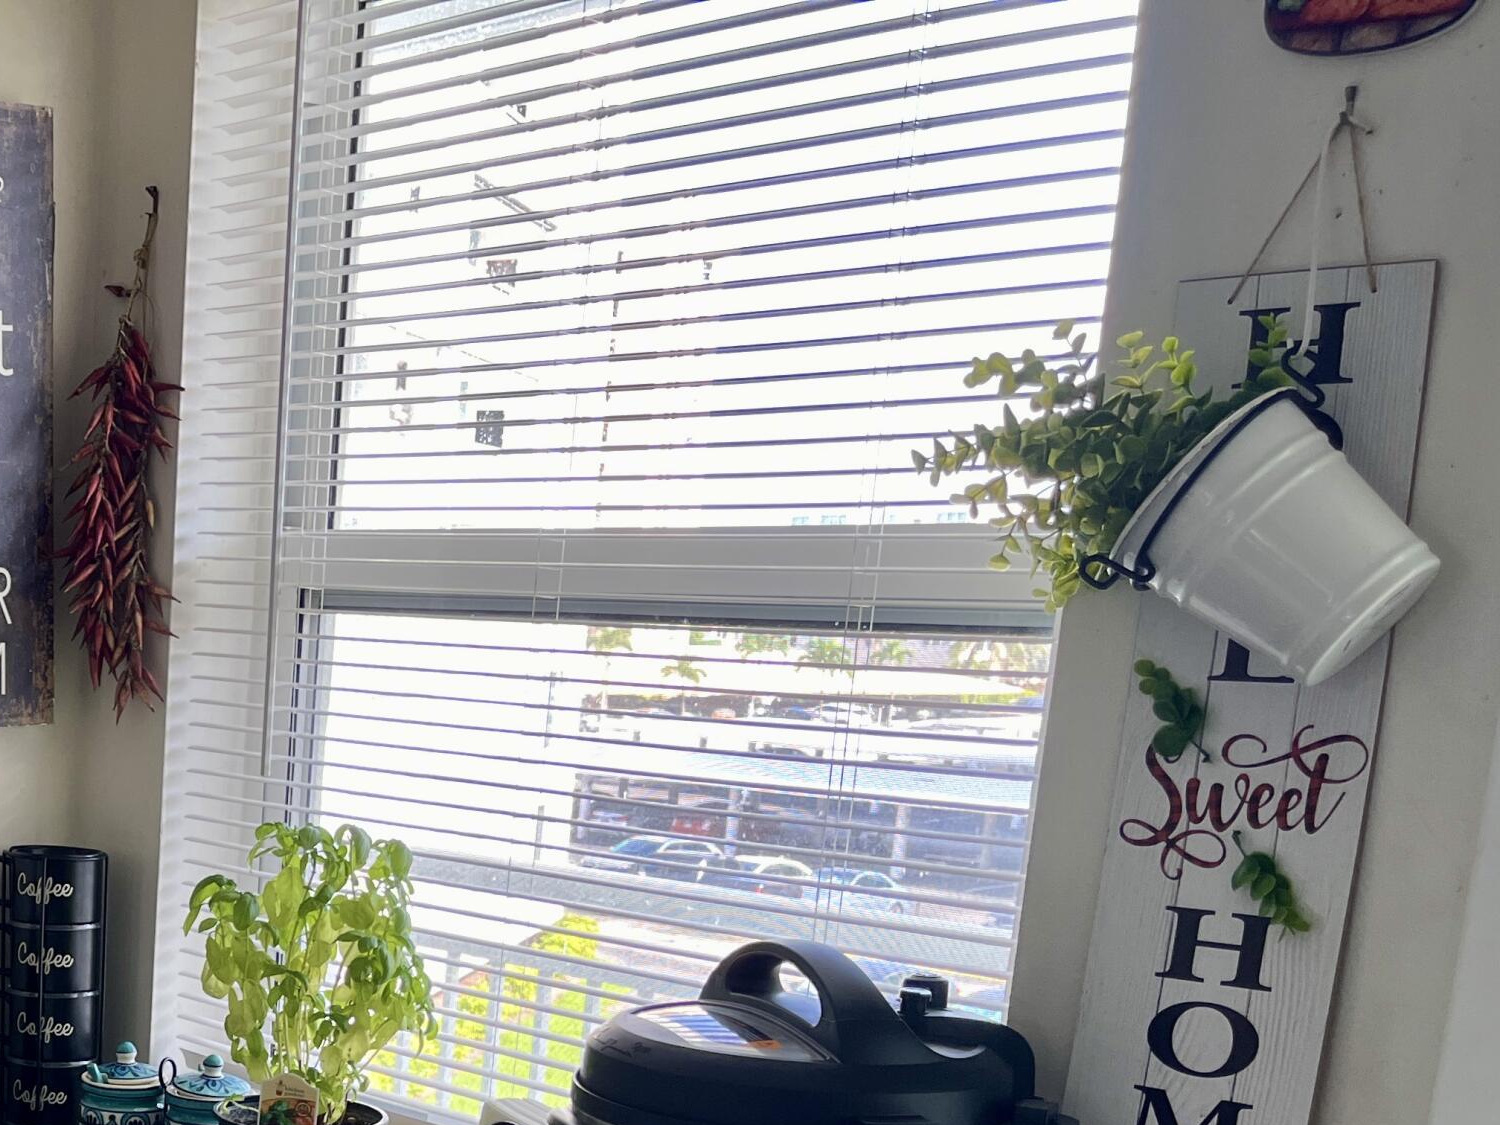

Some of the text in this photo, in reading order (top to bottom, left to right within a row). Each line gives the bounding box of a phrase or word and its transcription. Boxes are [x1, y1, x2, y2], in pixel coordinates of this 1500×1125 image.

[1119, 725, 1368, 880] Sweet
[17, 871, 74, 905] Coffee
[13, 1078, 68, 1112] Coffee
